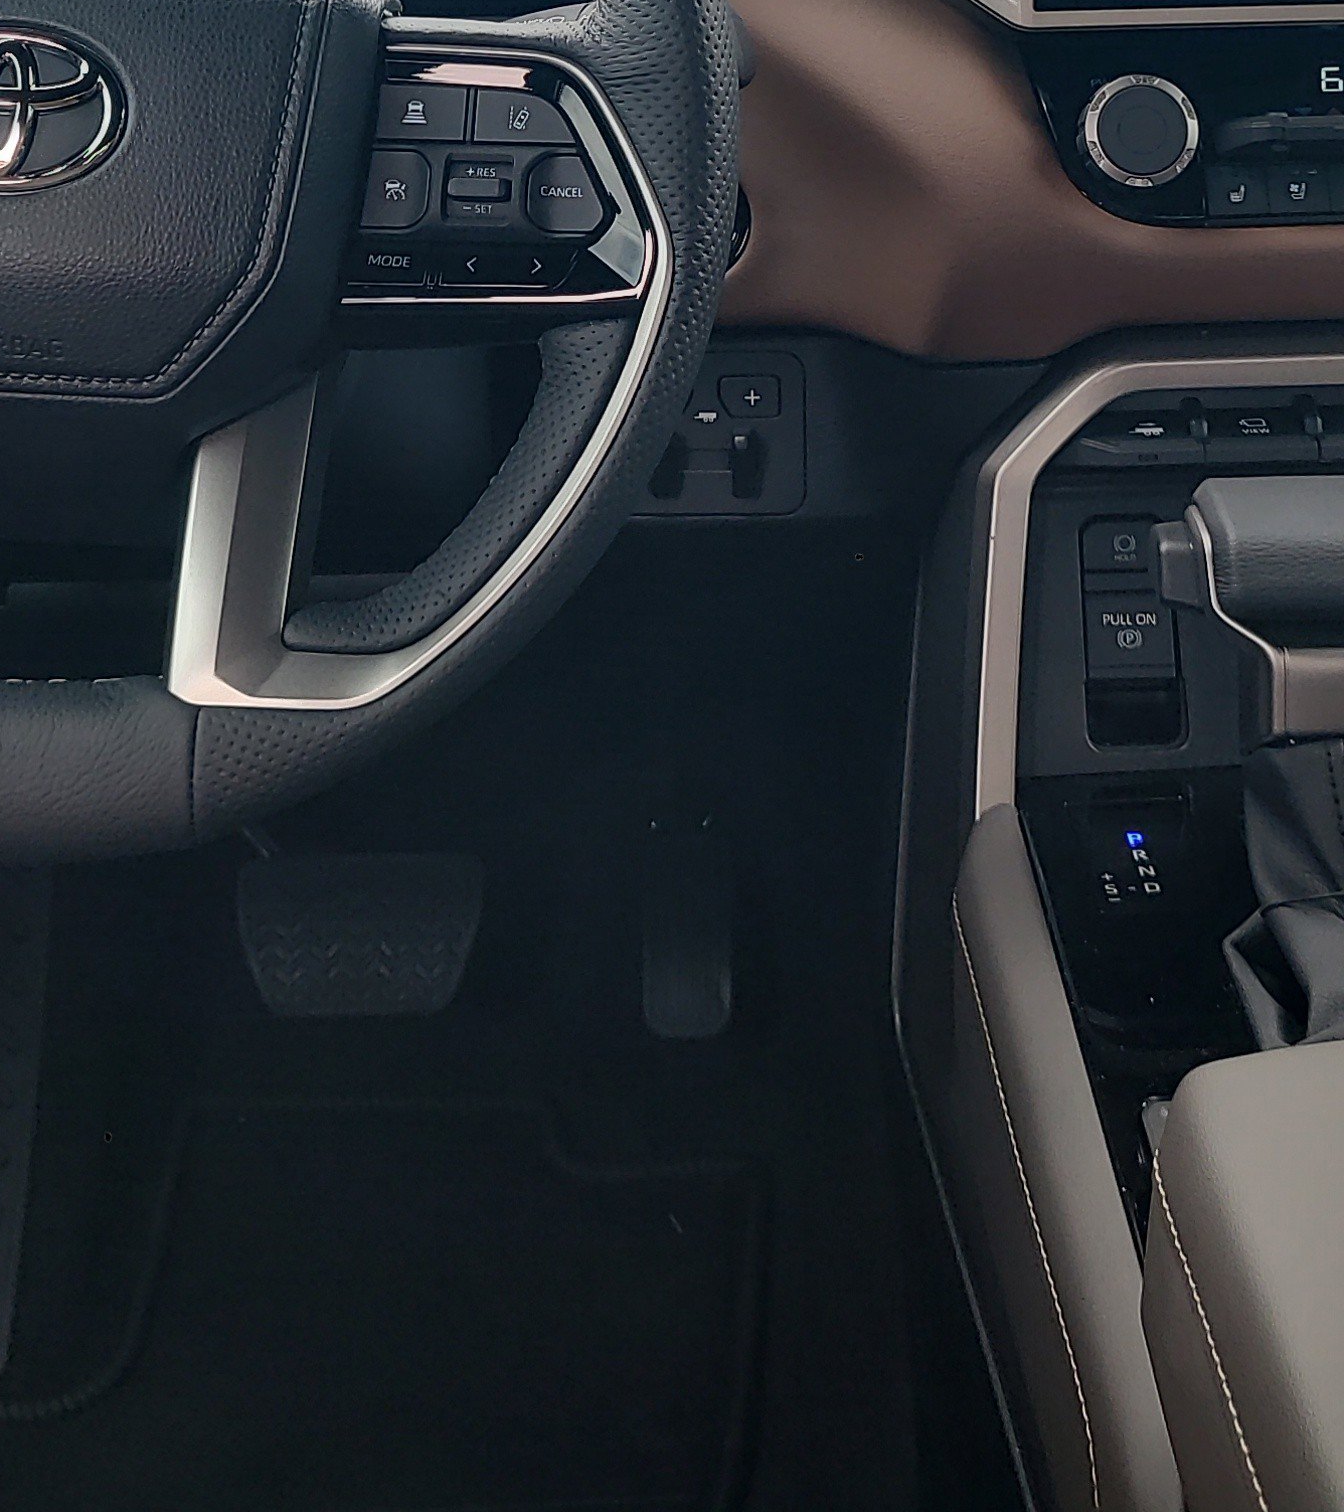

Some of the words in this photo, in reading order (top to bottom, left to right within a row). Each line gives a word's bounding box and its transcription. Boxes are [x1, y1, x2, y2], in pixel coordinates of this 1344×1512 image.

[540, 186, 583, 199] CANCEL
[368, 254, 411, 268] MODE
[1102, 613, 1132, 626] PULL
[1136, 613, 1157, 626] ON
[1126, 832, 1143, 848] P
[1132, 849, 1149, 861] R
[1138, 865, 1156, 877] N
[1144, 882, 1162, 894] D
